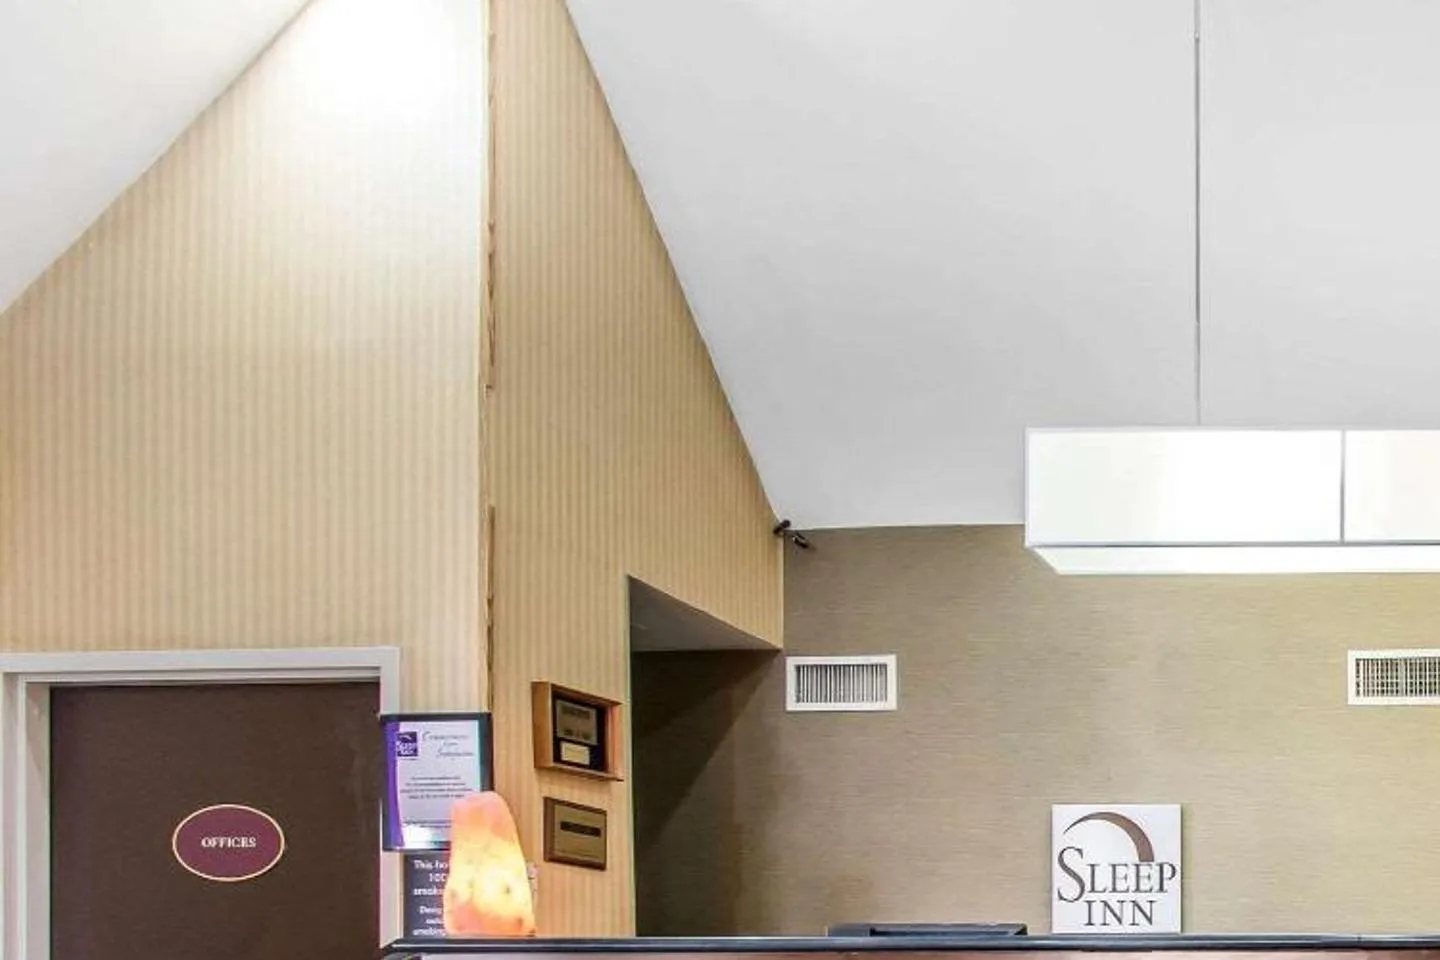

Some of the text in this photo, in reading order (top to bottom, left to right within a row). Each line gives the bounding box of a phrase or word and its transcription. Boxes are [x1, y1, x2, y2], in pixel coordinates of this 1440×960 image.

[201, 836, 257, 848] OFFICES
[413, 860, 433, 870] This
[1057, 846, 1177, 903] SLEEP
[1083, 900, 1157, 926] INN
